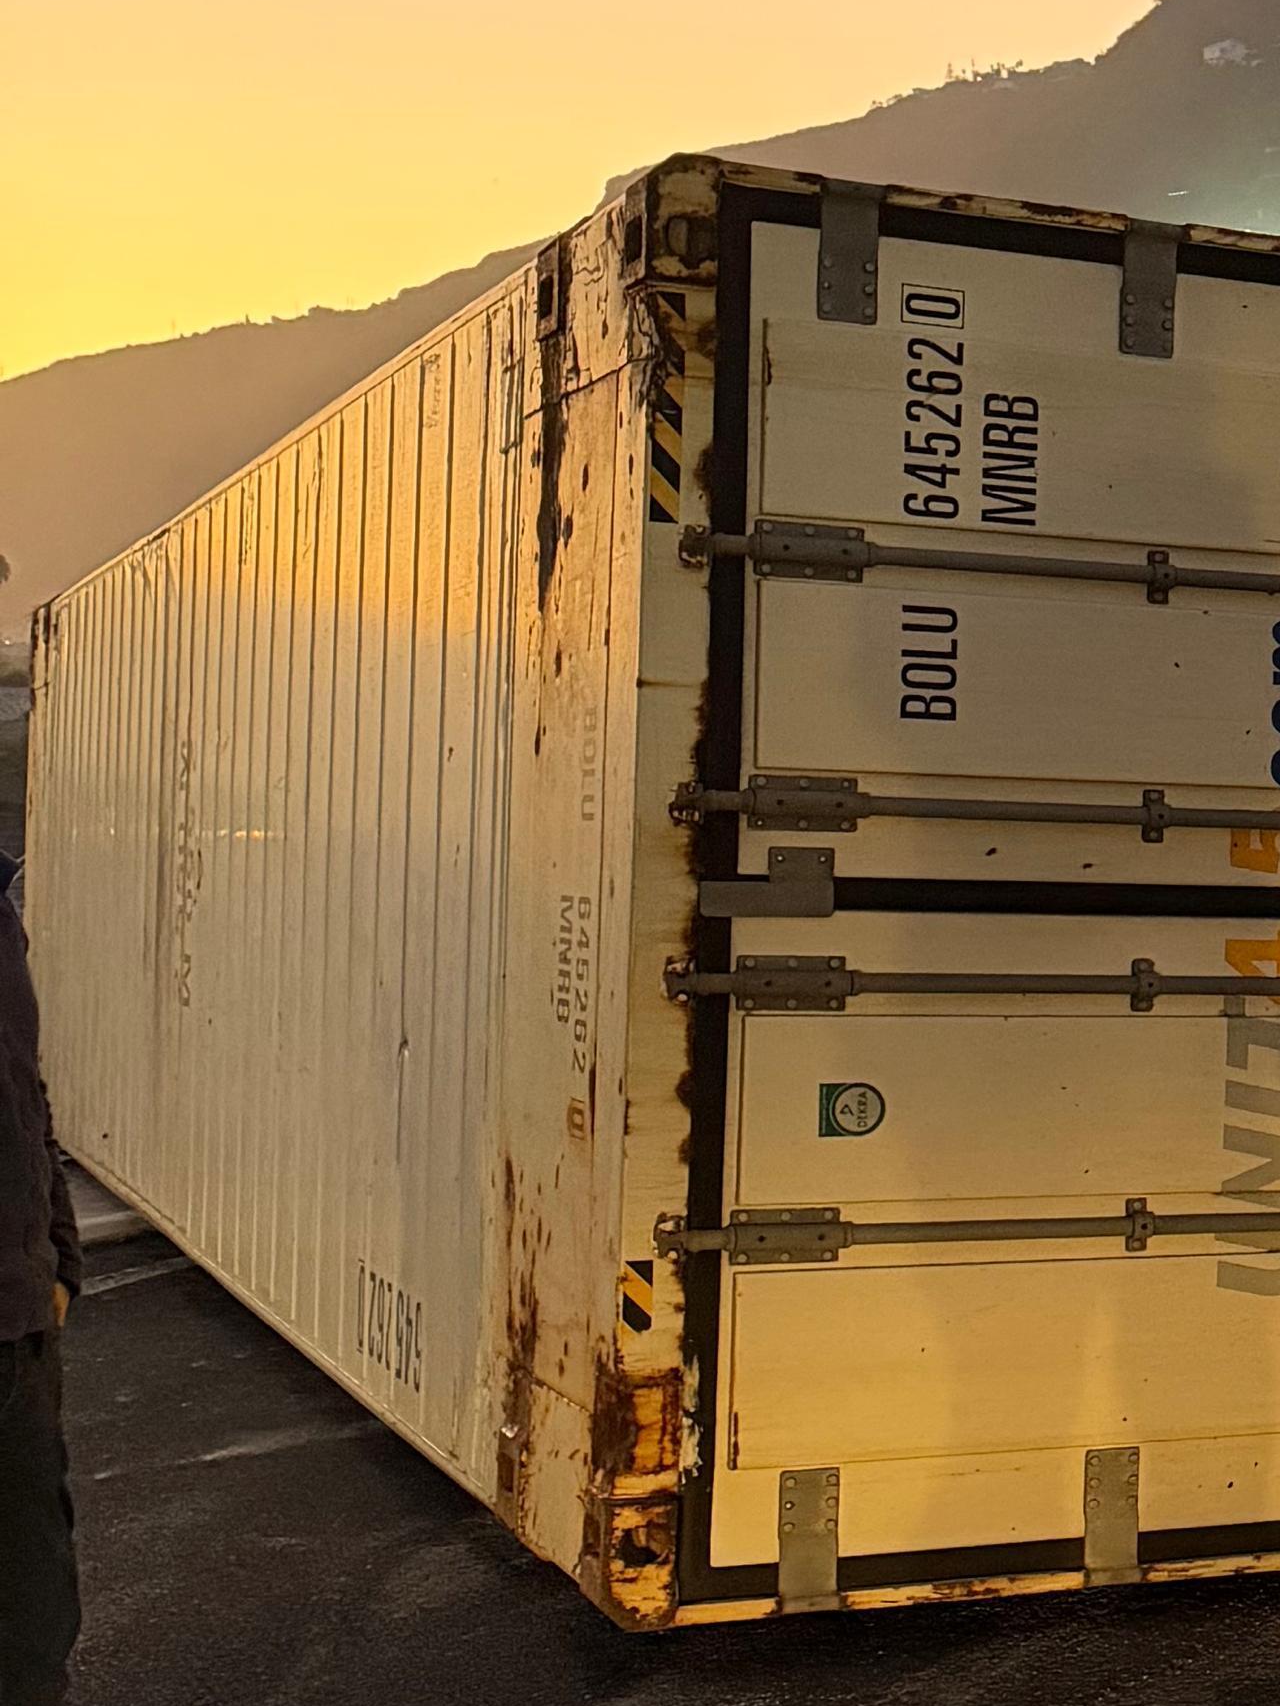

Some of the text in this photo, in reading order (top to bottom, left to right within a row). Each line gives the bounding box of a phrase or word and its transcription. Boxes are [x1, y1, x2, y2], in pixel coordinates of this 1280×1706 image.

[903, 337, 965, 520] 645262
[981, 392, 1039, 527] MNRB
[901, 605, 958, 721] BOLU
[556, 894, 574, 1025] MNRB
[572, 895, 592, 1075] 645262
